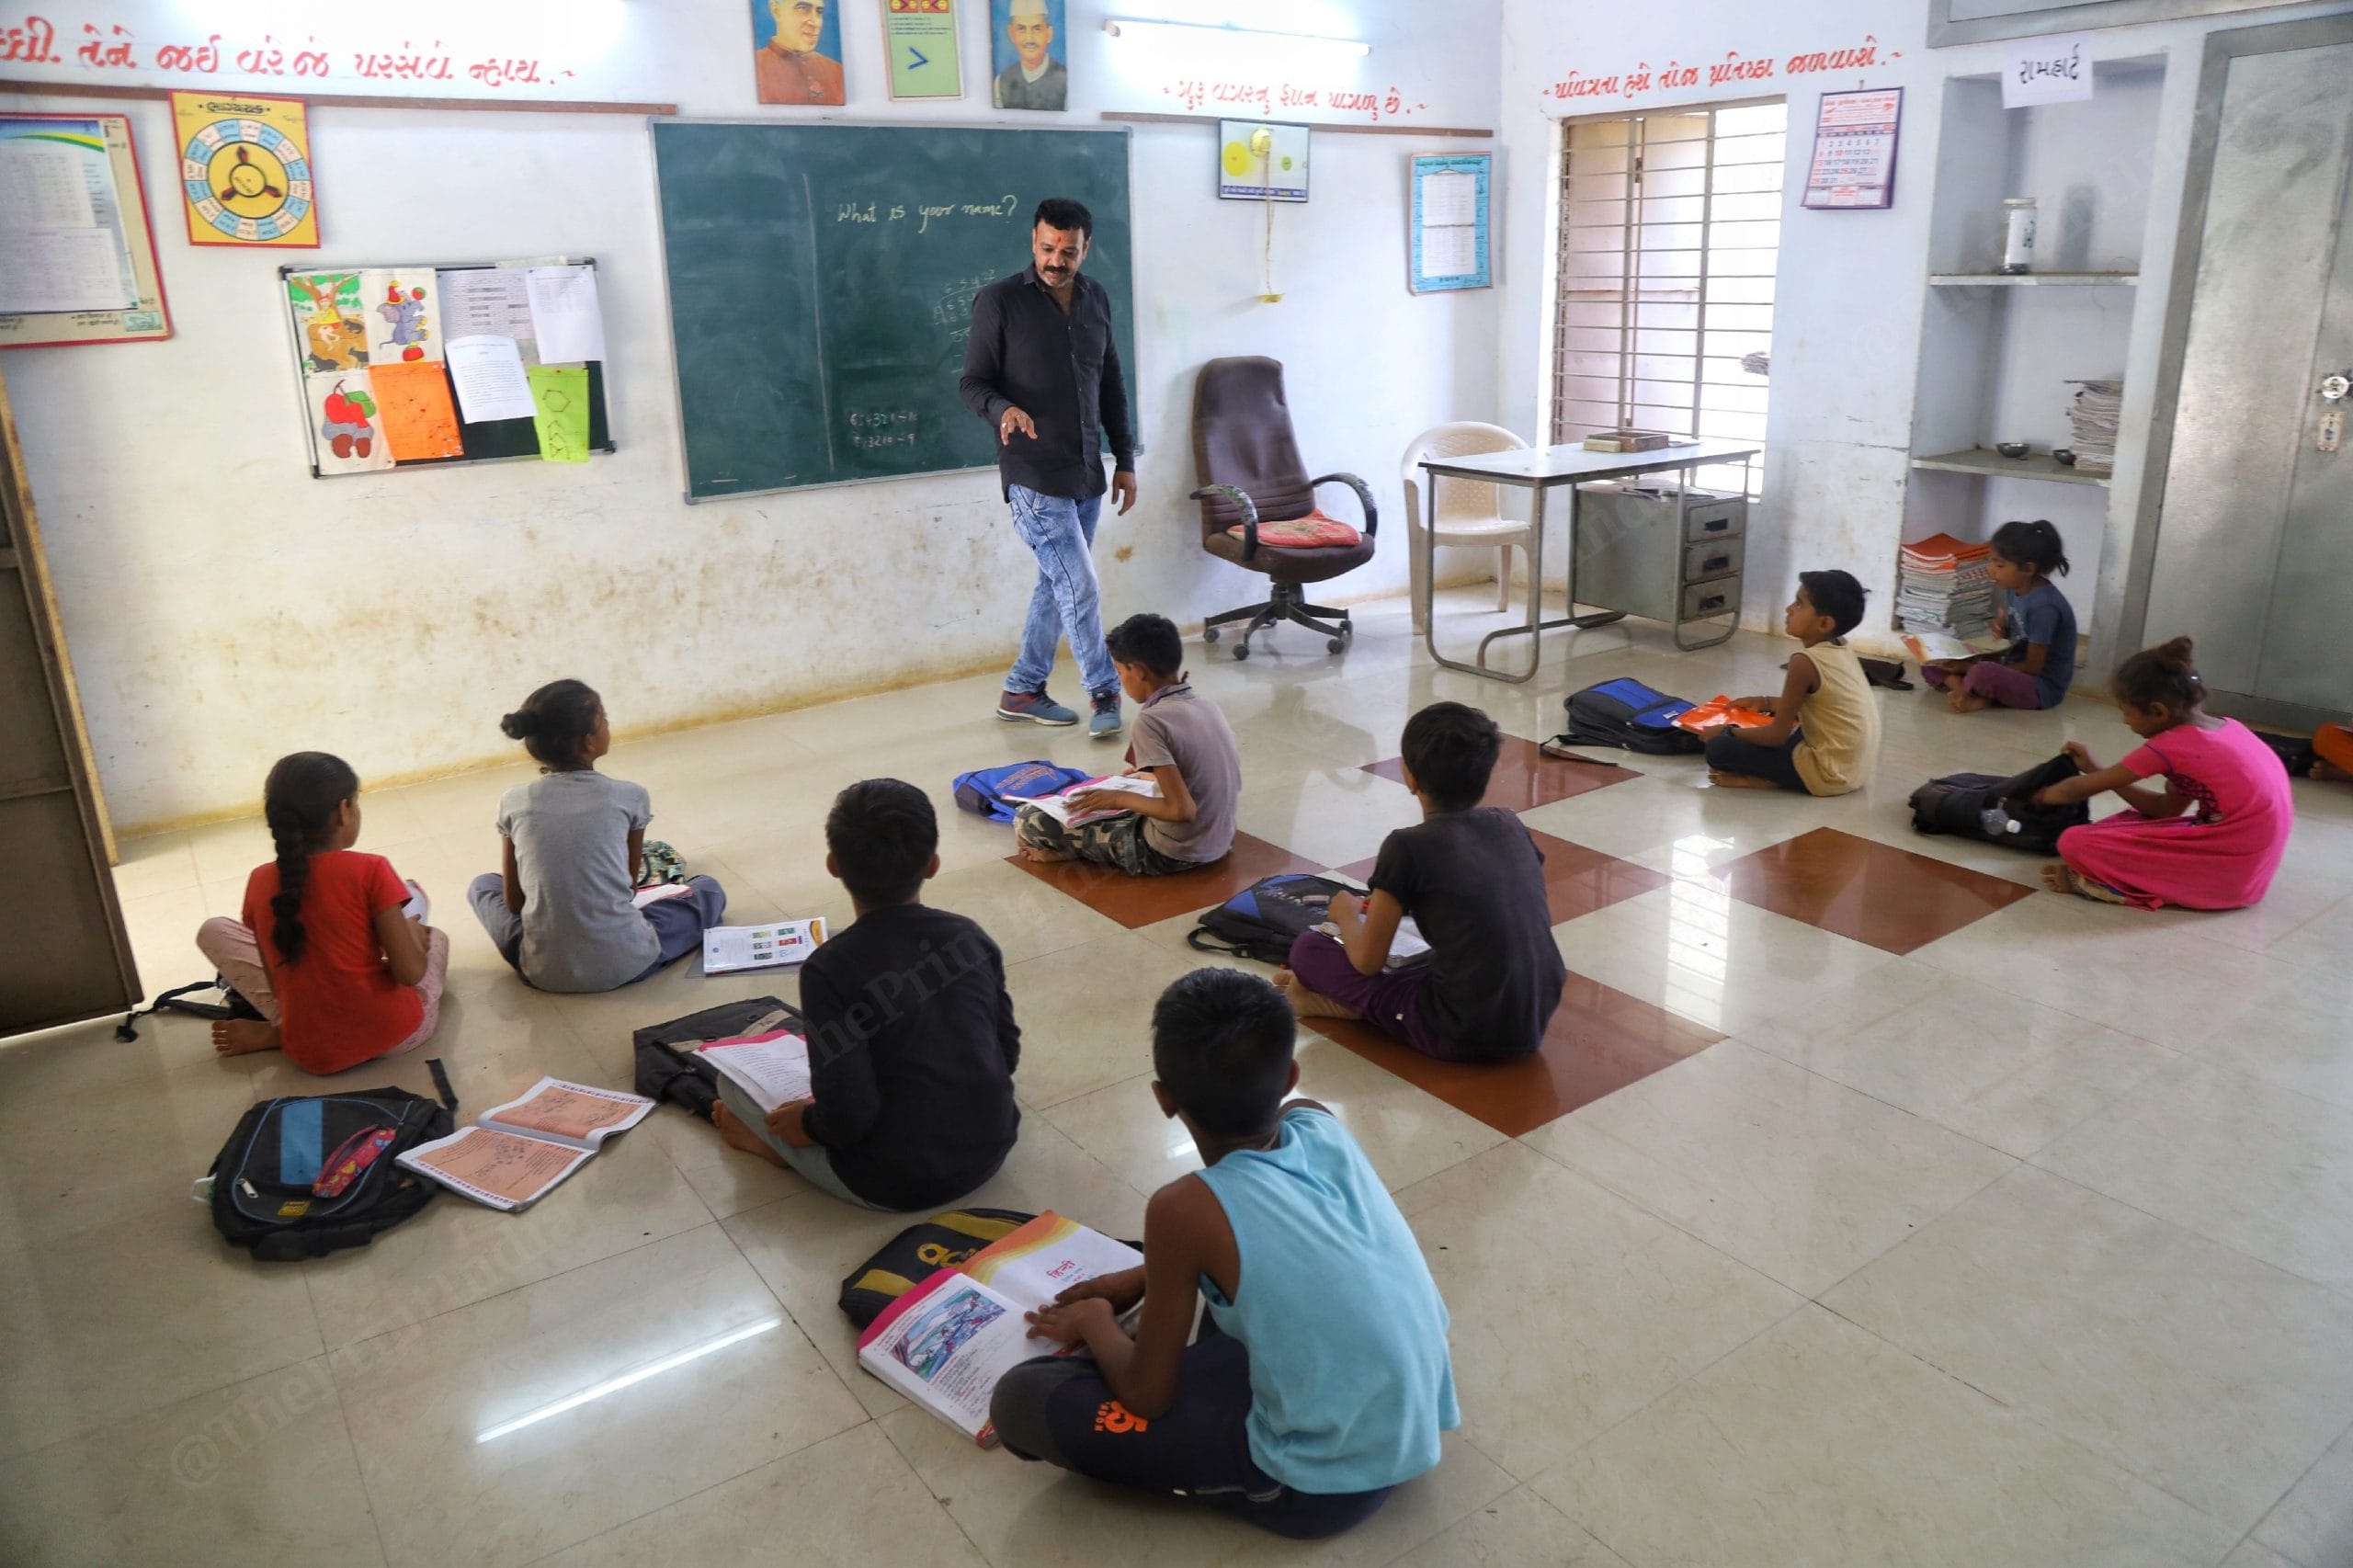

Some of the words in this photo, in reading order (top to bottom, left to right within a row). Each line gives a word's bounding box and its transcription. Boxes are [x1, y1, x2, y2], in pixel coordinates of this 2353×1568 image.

[77, 23, 138, 71] તેને
[837, 201, 877, 222] What
[888, 204, 906, 222] is
[919, 204, 956, 234] your
